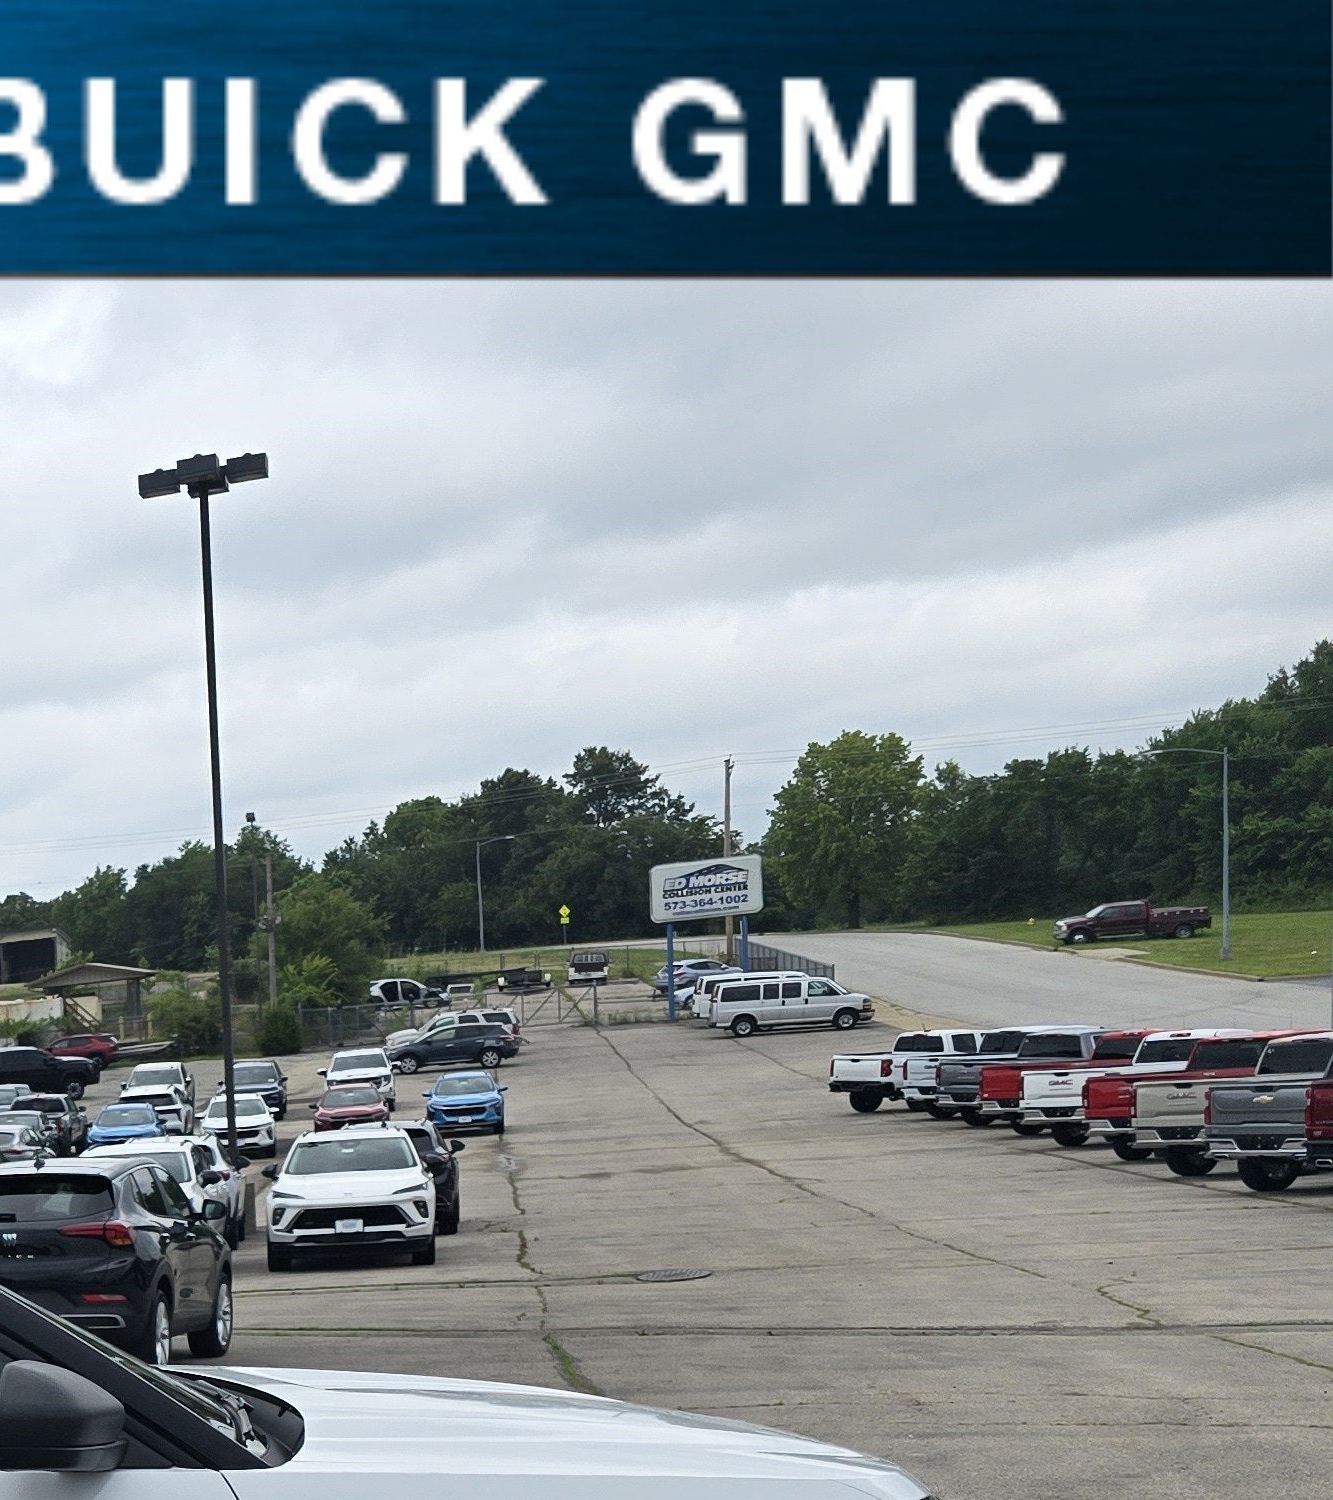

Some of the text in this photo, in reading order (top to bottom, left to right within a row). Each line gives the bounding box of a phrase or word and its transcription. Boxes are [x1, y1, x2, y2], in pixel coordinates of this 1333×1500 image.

[665, 871, 748, 890] ED MORSE
[663, 885, 748, 899] COLLISION CENTER
[664, 894, 749, 911] 573-364-1002
